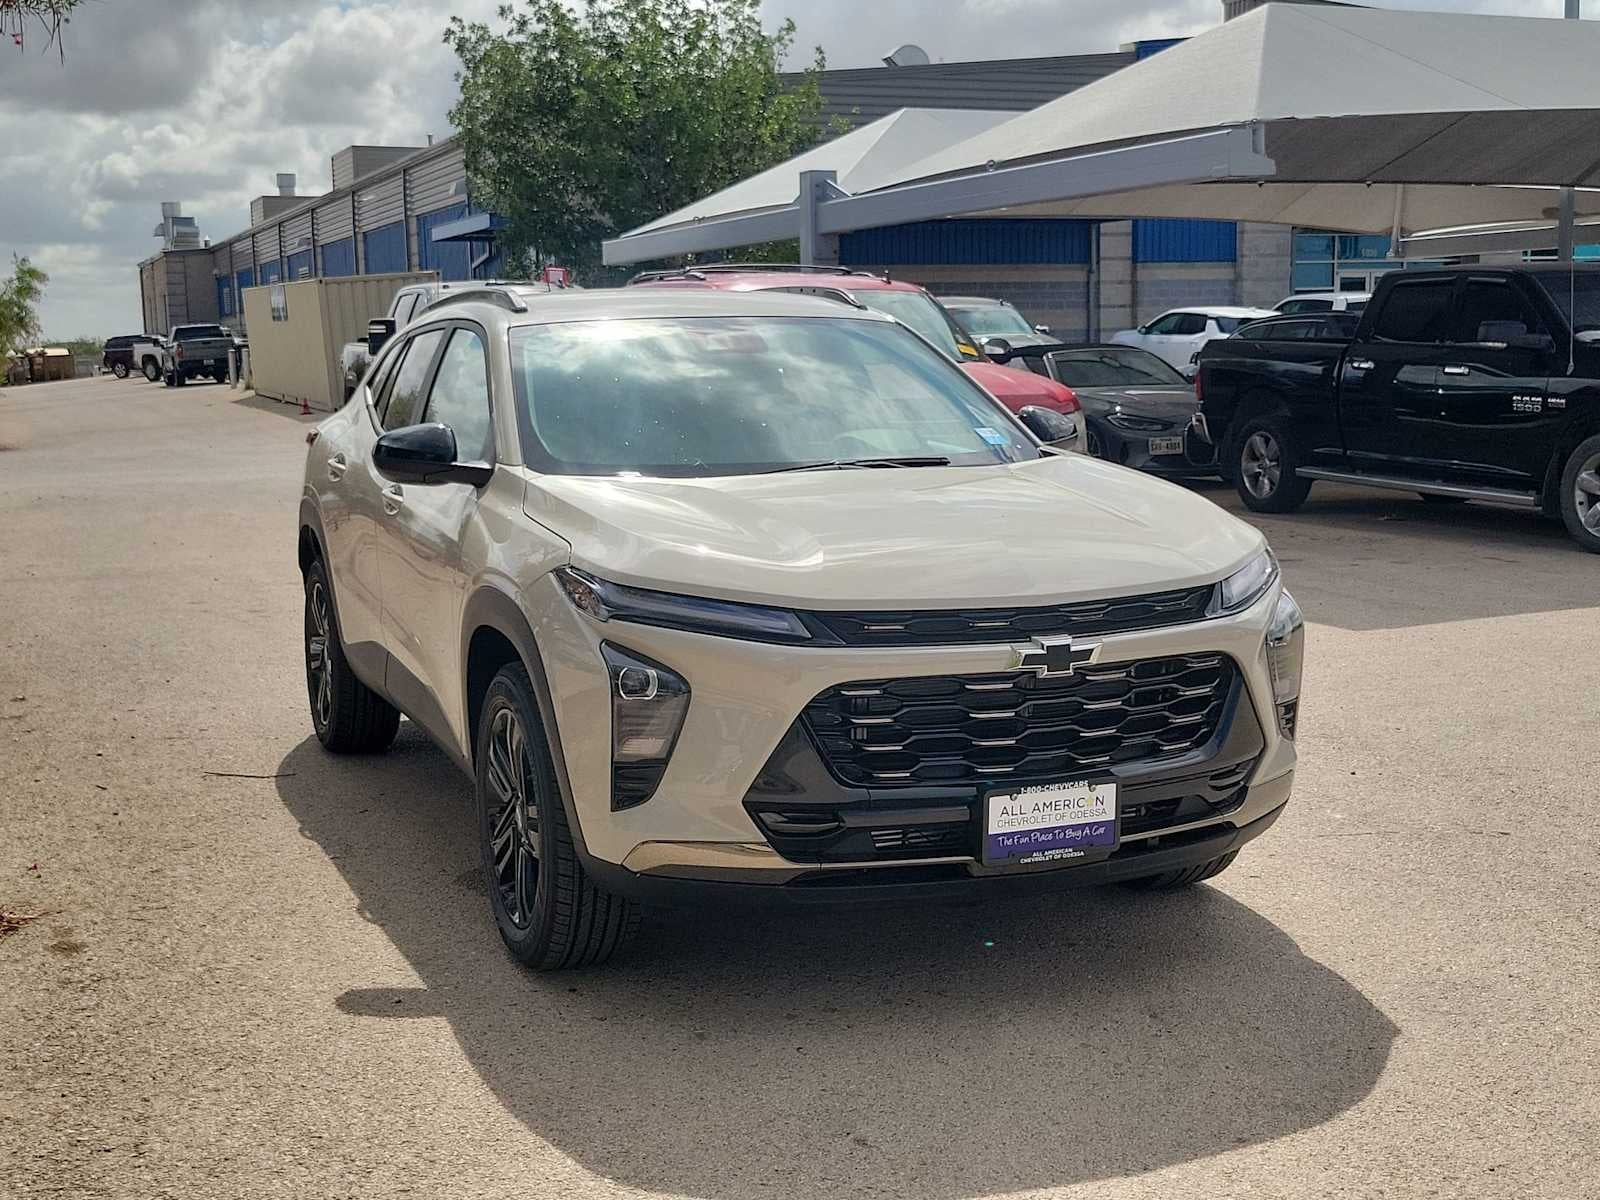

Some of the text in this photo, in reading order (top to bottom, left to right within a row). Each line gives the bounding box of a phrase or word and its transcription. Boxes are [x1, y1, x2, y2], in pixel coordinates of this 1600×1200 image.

[1020, 780, 1089, 795] 1-800-CHEVYCARS
[999, 804, 1026, 818] ALL
[997, 808, 1107, 829] CHEVROLET OF ODESSA
[998, 825, 1106, 847] The Fun Place To Buy A Car
[1020, 855, 1053, 864] CHEVROLET
[1063, 851, 1085, 859] ODESSA
[1044, 848, 1073, 856] AMERICAN
